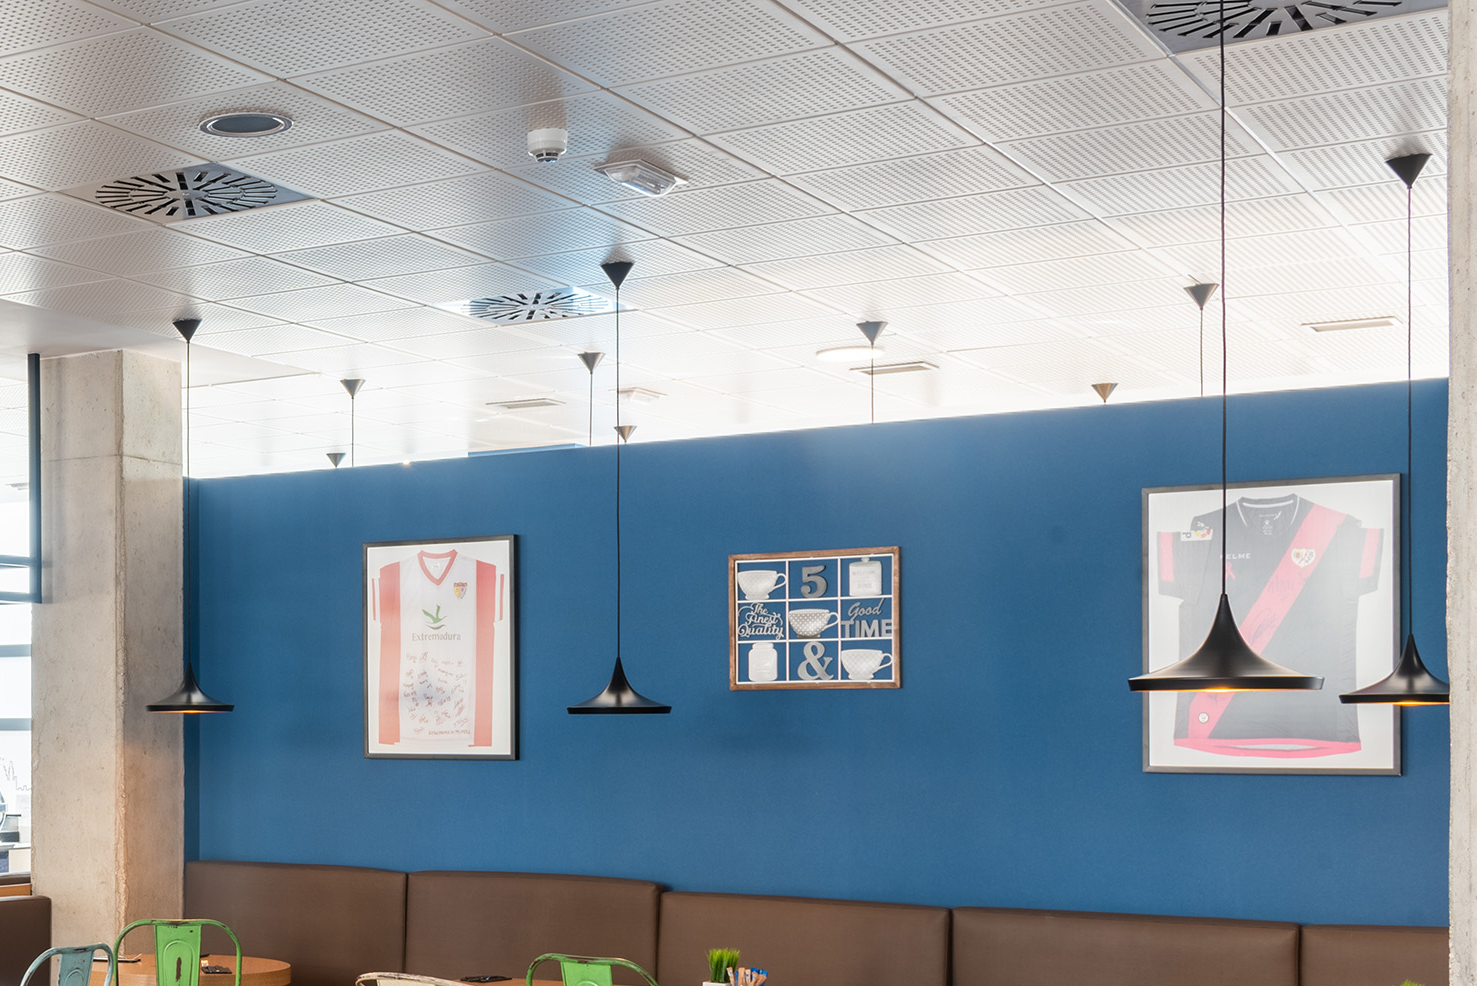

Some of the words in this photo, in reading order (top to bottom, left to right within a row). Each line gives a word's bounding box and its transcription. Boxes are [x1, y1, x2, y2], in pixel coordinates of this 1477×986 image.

[801, 565, 828, 599] 5
[848, 598, 885, 618] Good
[411, 632, 461, 641] Extremadura
[738, 623, 784, 640] Quality
[840, 618, 893, 638] TIME
